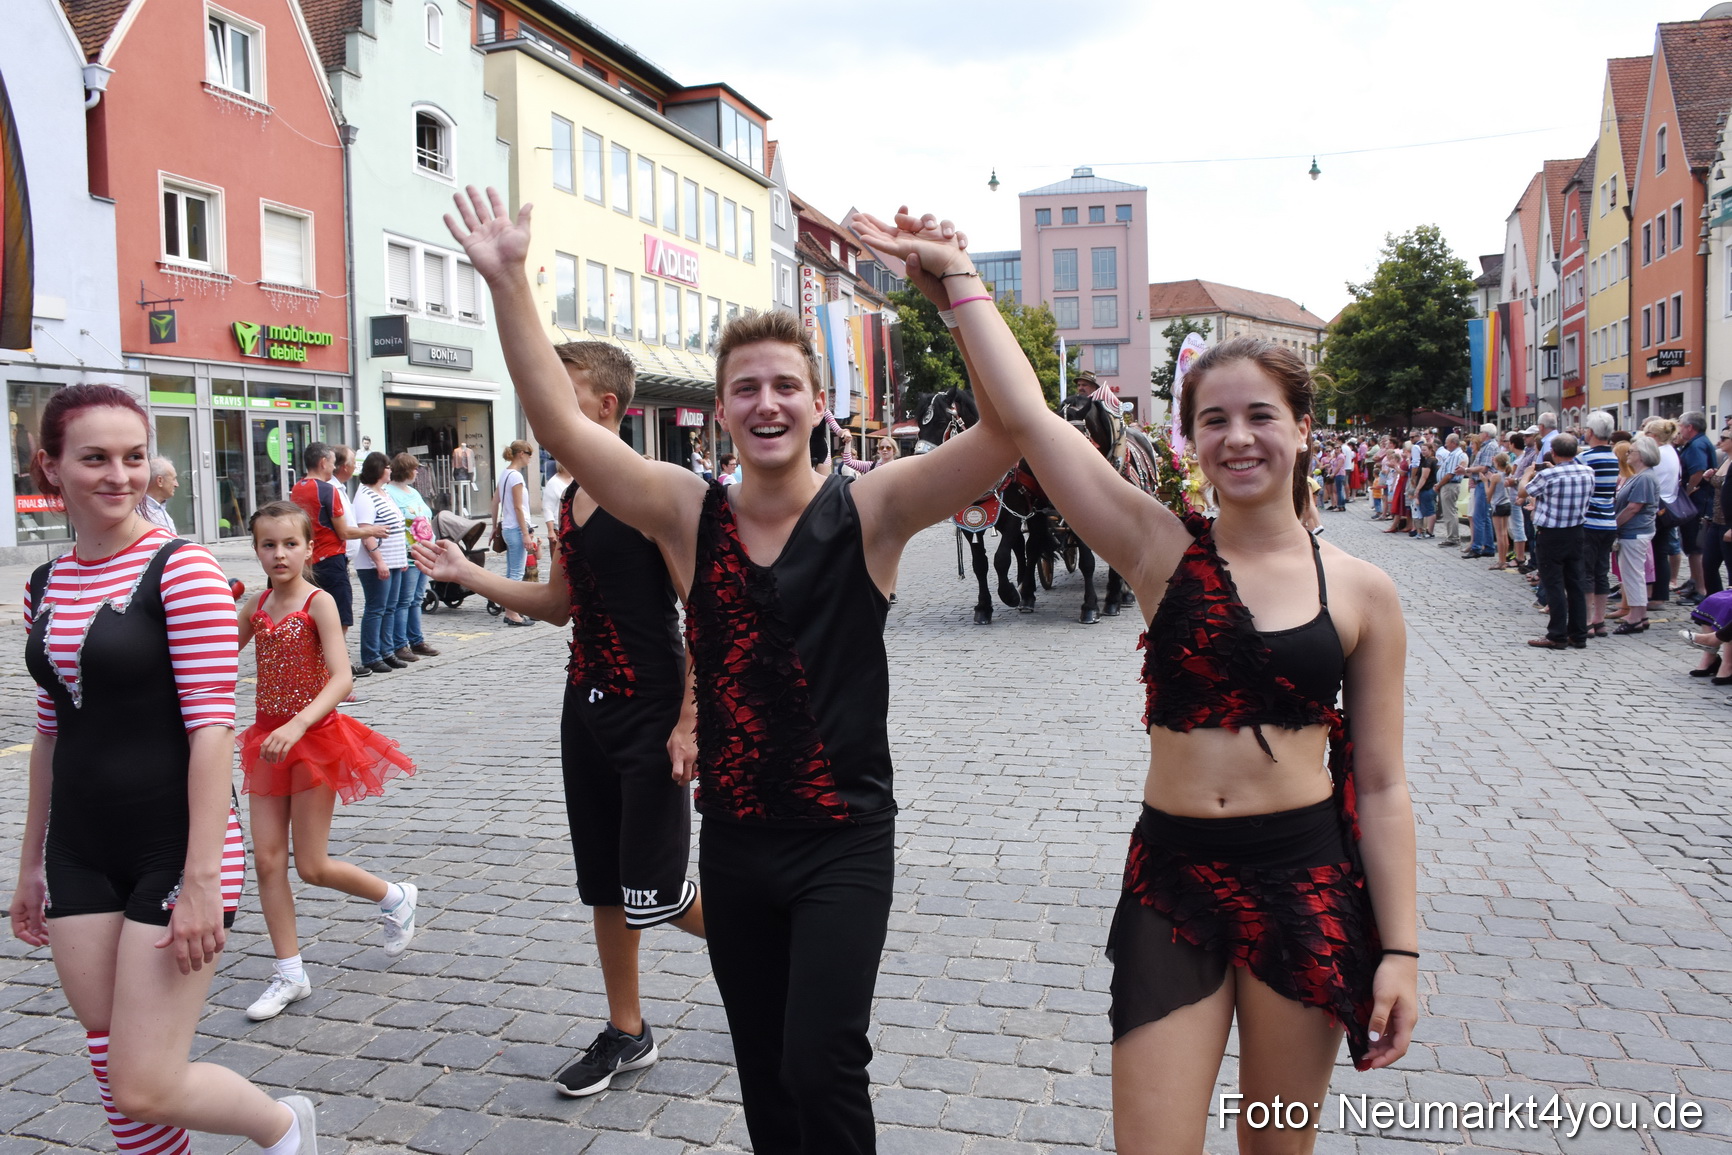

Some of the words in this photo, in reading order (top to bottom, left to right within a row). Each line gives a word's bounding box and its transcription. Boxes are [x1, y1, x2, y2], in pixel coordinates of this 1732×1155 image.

[652, 240, 699, 284] ADLER
[268, 325, 333, 345] mobilcom
[268, 343, 308, 362] debitel
[1660, 351, 1684, 359] MATT
[213, 395, 242, 407] GRAVIS
[682, 408, 704, 426] ADLER
[18, 499, 37, 508] FINAL
